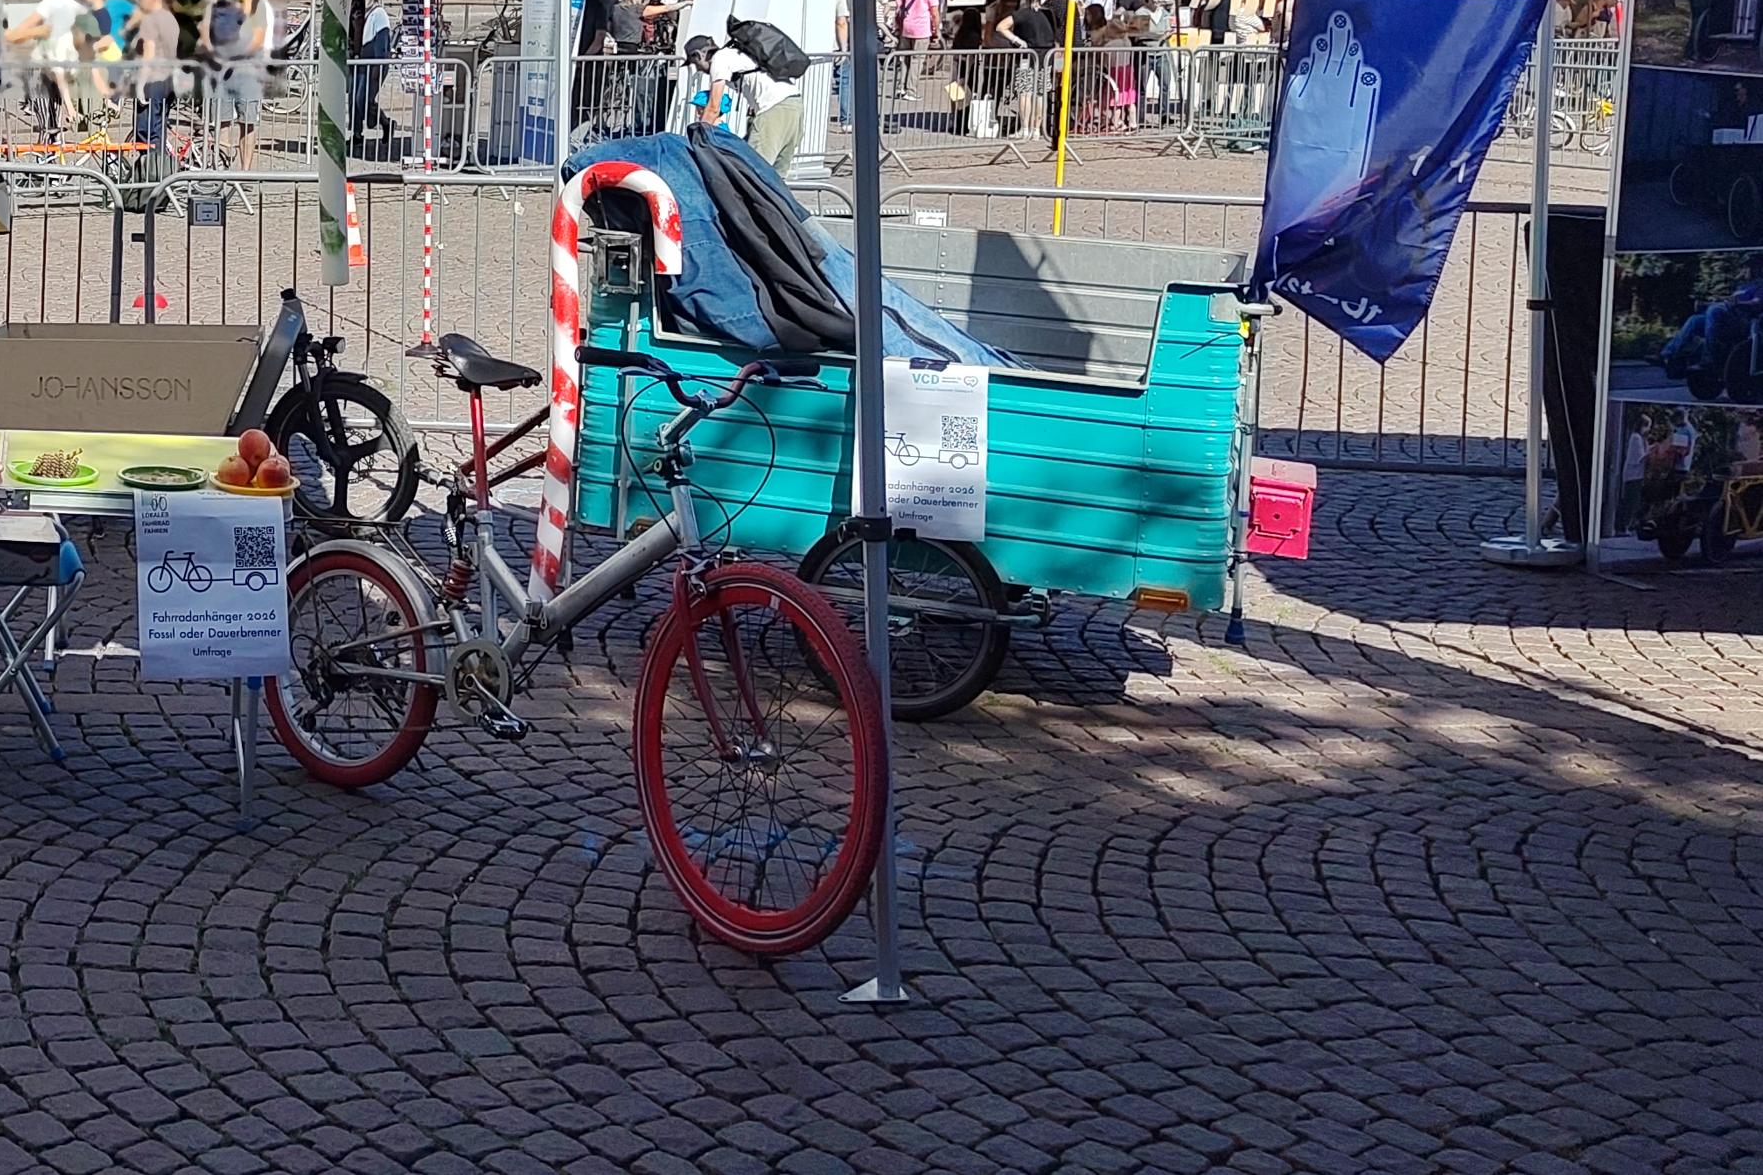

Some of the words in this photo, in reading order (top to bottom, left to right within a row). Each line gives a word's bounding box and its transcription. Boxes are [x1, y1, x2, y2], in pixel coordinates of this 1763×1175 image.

[912, 373, 940, 385] VCD
[30, 376, 192, 401] JOHANSSON
[948, 485, 975, 495] 2026
[888, 495, 910, 504] oder
[913, 496, 979, 509] Dauerbrenner
[898, 511, 934, 522] Umfrage
[152, 609, 243, 624] Fahrradanhänger
[247, 609, 277, 621] 2026
[148, 627, 176, 640] Fossil
[179, 627, 205, 639] oder
[208, 626, 283, 639] Dauerbrenner
[192, 646, 233, 658] Umfrage
